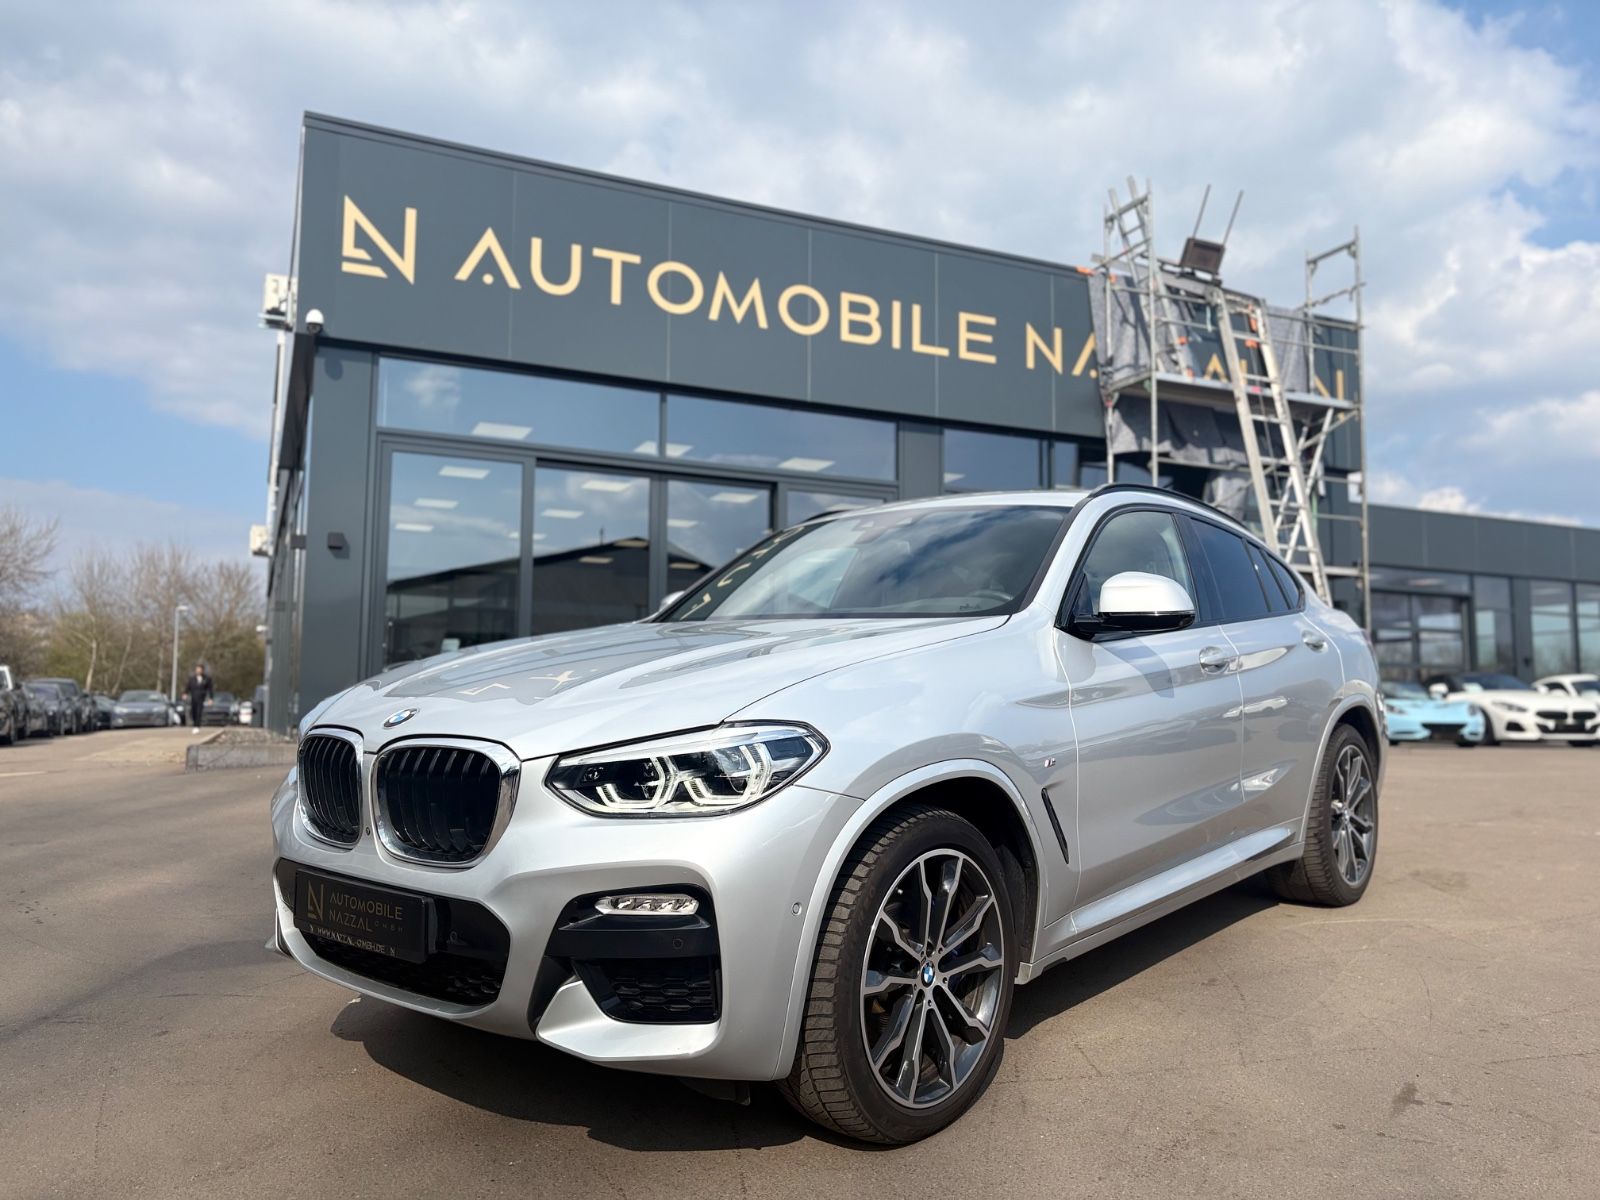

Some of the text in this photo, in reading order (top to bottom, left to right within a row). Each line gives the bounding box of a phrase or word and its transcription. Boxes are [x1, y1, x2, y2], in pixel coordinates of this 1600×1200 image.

[454, 226, 998, 365] AUTOMOBILE
[329, 891, 404, 920] AUTOMOBILE
[329, 909, 374, 933] NAZZAL
